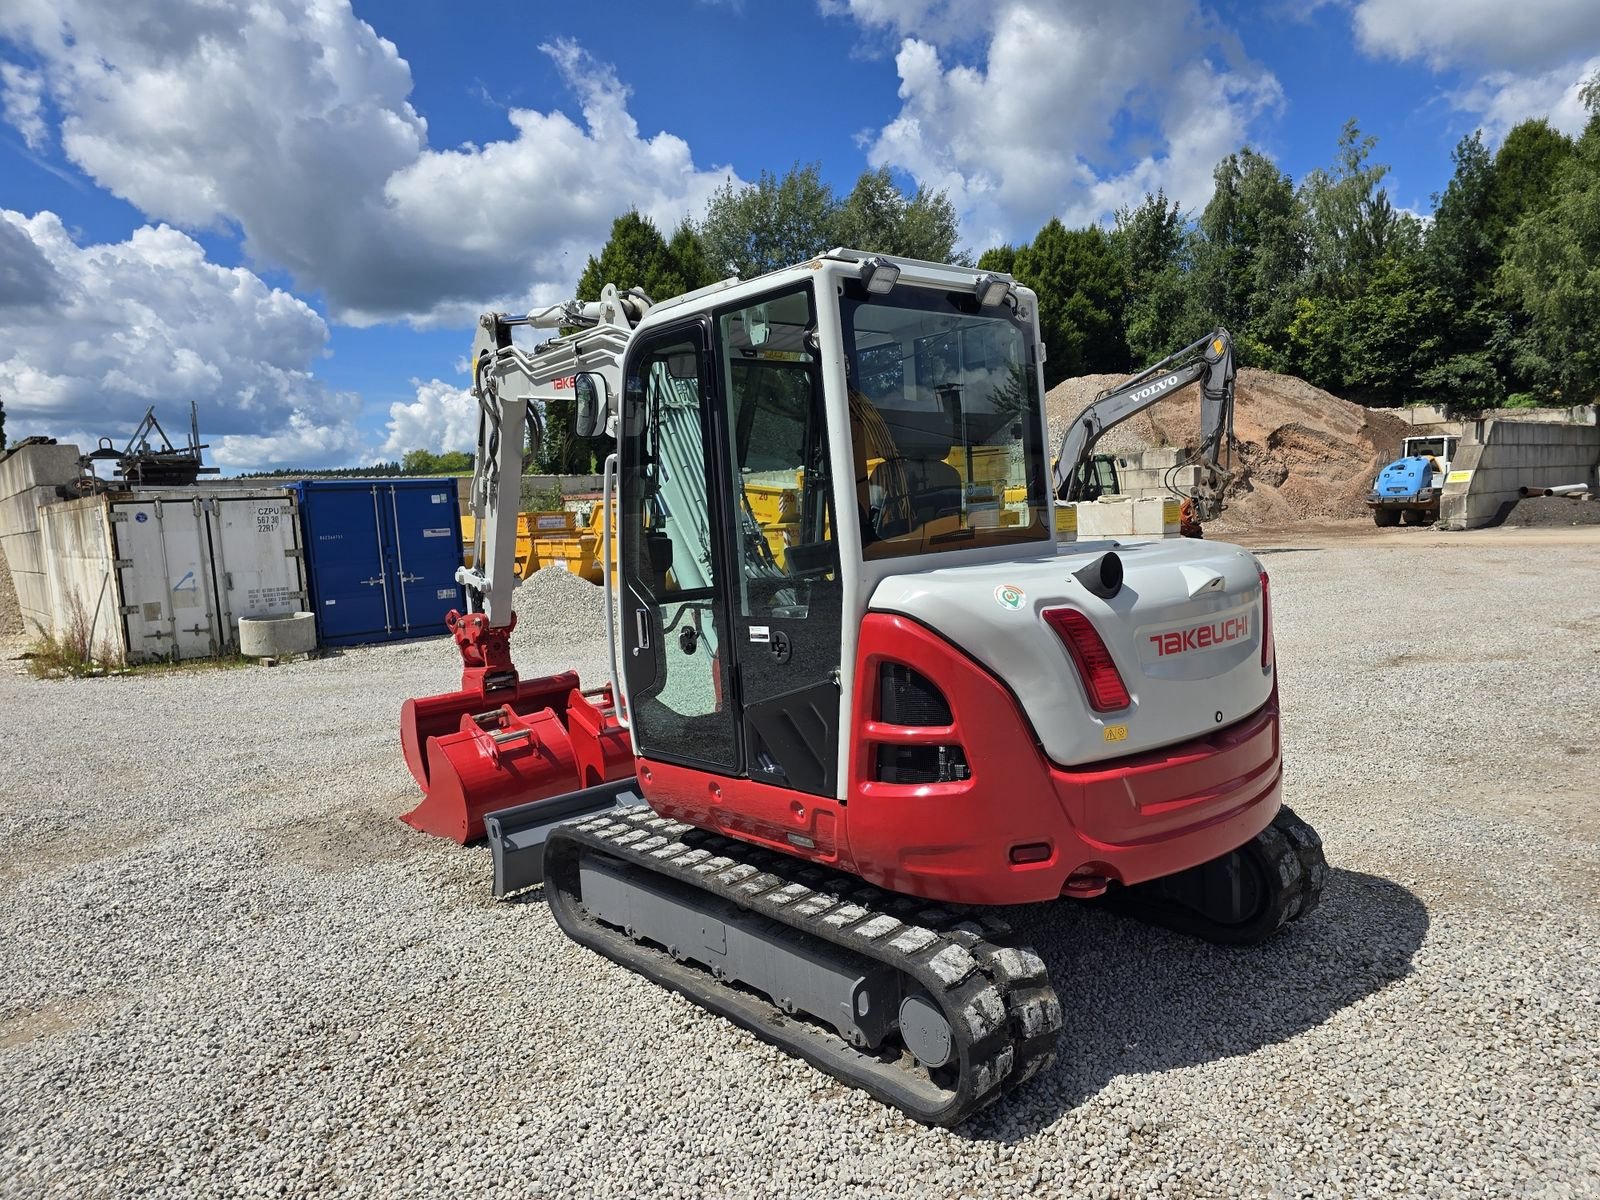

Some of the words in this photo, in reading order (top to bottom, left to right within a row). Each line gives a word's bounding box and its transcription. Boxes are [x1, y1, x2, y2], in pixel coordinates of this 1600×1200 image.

[1129, 375, 1178, 402] VOLVO
[759, 492, 768, 501] 20
[258, 507, 279, 515] CZPU
[258, 524, 274, 532] 22R1
[1150, 615, 1248, 656] TAKEUCHI
